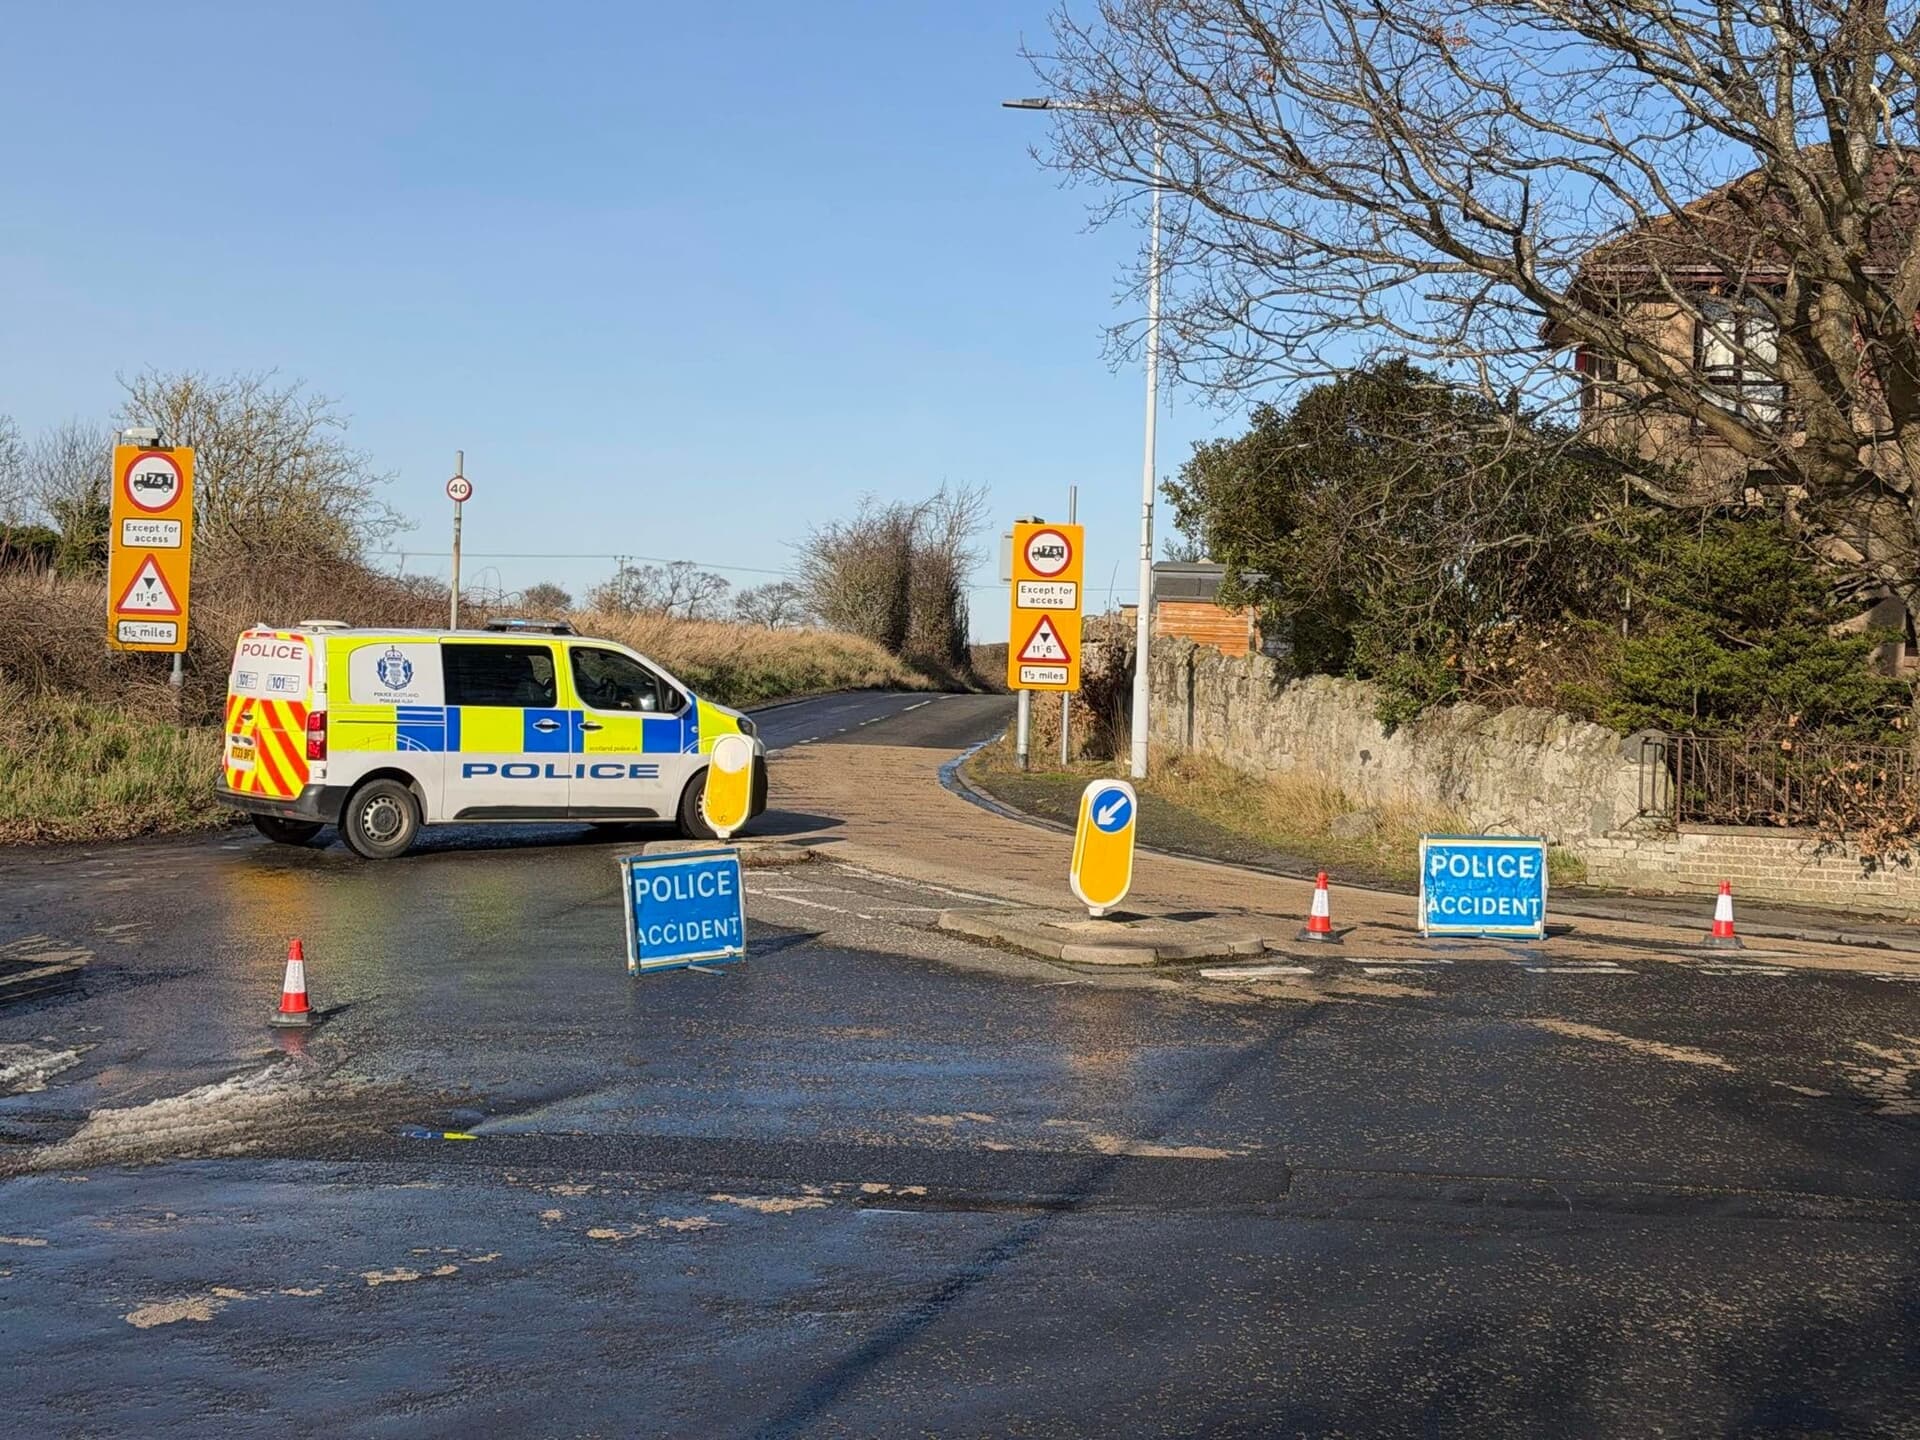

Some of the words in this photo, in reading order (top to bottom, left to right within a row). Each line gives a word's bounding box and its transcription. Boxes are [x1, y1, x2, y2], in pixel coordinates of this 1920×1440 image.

[450, 483, 468, 494] 40
[126, 523, 160, 533] Except
[164, 524, 178, 533] for
[134, 535, 169, 543] access
[1021, 585, 1055, 595] Except
[1059, 586, 1073, 595] for
[1030, 597, 1064, 605] access
[140, 627, 172, 638] miles
[241, 643, 303, 660] POLICE
[1039, 671, 1064, 680] miles
[272, 676, 286, 689] 101
[462, 763, 659, 779] POLICE
[1430, 854, 1536, 878] POLICE
[635, 870, 732, 904] POLICE
[1428, 896, 1540, 917] ACCIDENT
[638, 917, 739, 946] ACCIDENT
